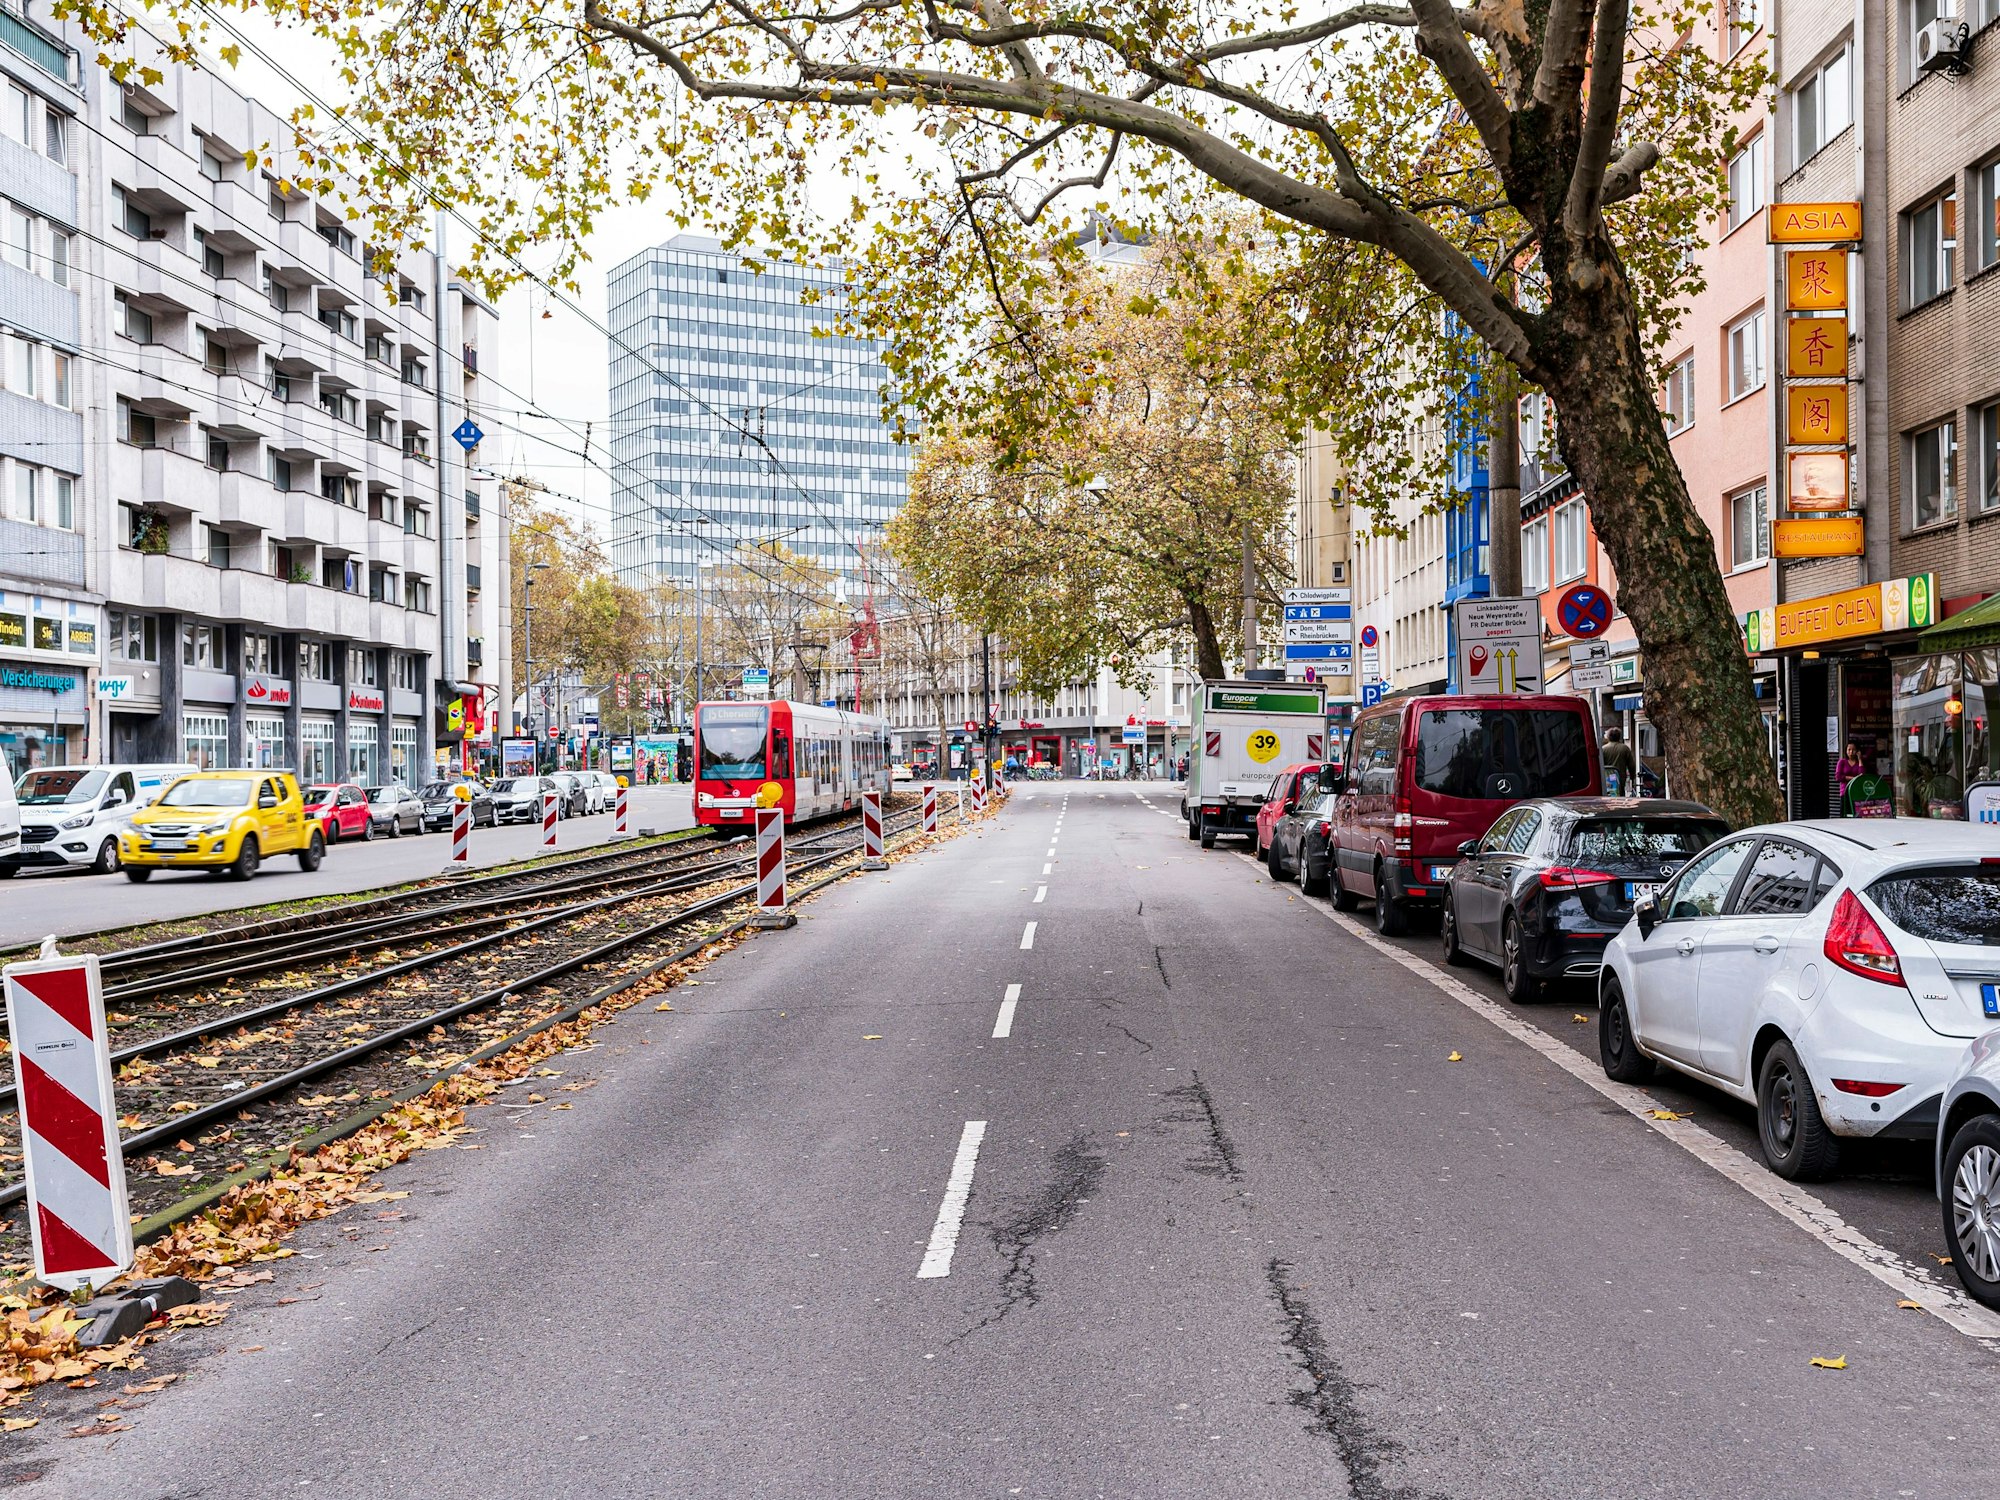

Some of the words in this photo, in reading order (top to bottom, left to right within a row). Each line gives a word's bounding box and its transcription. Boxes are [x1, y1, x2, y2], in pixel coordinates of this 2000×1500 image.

[1784, 211, 1849, 231] ASIA
[1778, 531, 1859, 544] RESTAURANT
[1300, 592, 1340, 600] Chlodwigplatz
[1476, 604, 1519, 612] Linksabbieger
[1485, 611, 1524, 620] Weyerstraße
[1779, 606, 1830, 638] BUFFET
[1834, 596, 1877, 628] CHEN
[41, 626, 53, 639] Sie
[70, 630, 94, 644] ARBEIT
[1, 668, 76, 694] Versicherungen
[99, 680, 127, 698] wgv
[355, 694, 383, 710] Santander
[1221, 693, 1258, 703] Europcar
[1366, 688, 1377, 705] P
[1255, 735, 1276, 749] 39
[1440, 868, 1446, 878] K
[1634, 884, 1643, 897] K
